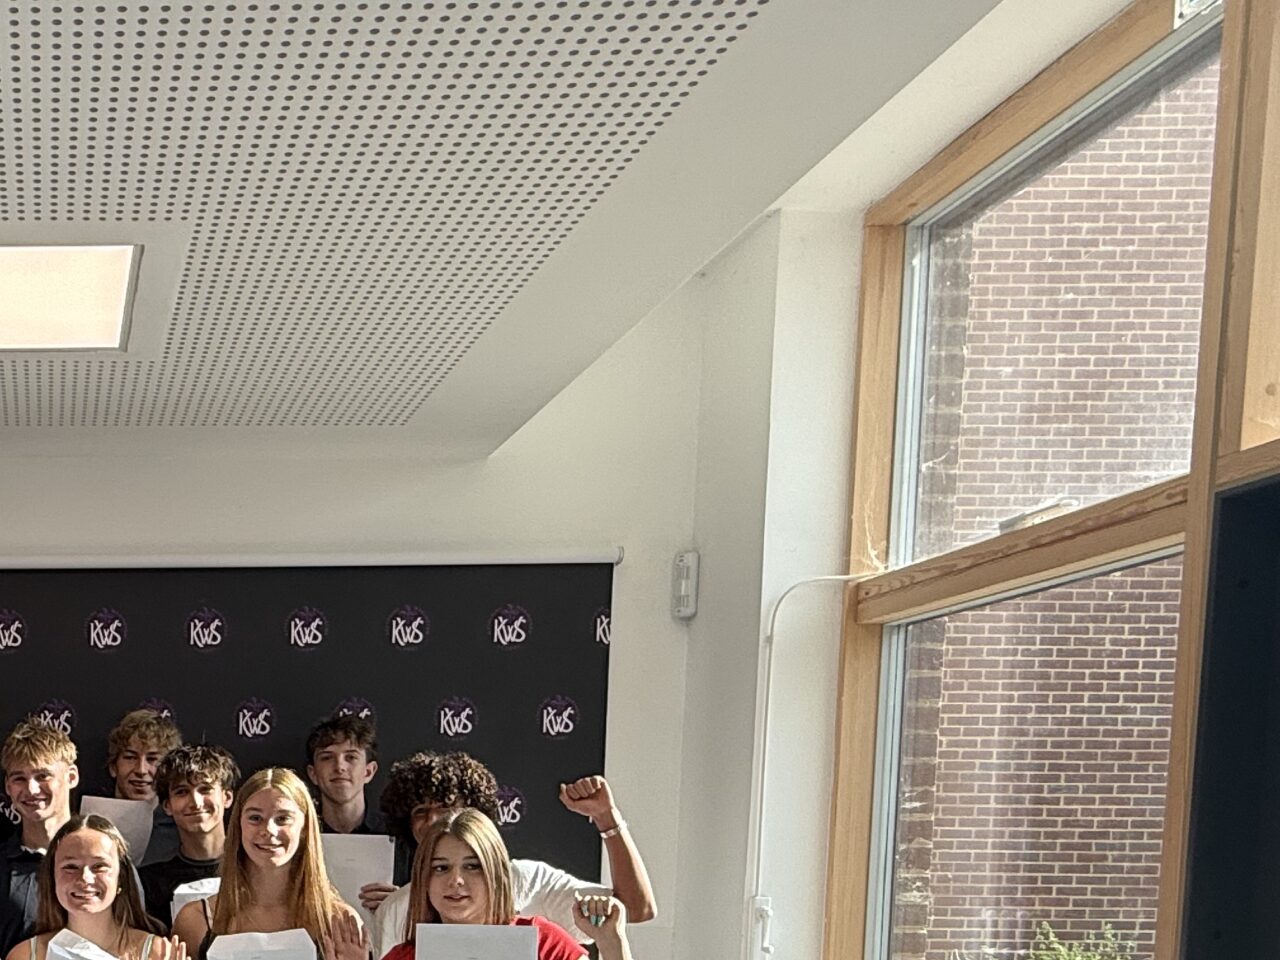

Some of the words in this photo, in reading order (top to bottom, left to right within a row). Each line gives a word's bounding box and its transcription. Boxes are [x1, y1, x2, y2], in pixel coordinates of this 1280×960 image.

[91, 620, 121, 648] KWS
[191, 619, 221, 647] KWS
[291, 618, 322, 646] KWS
[392, 617, 423, 646] KWS
[494, 616, 526, 645] KWS
[239, 709, 270, 737] KWS
[441, 708, 472, 736] KWS
[543, 707, 574, 735] KWS
